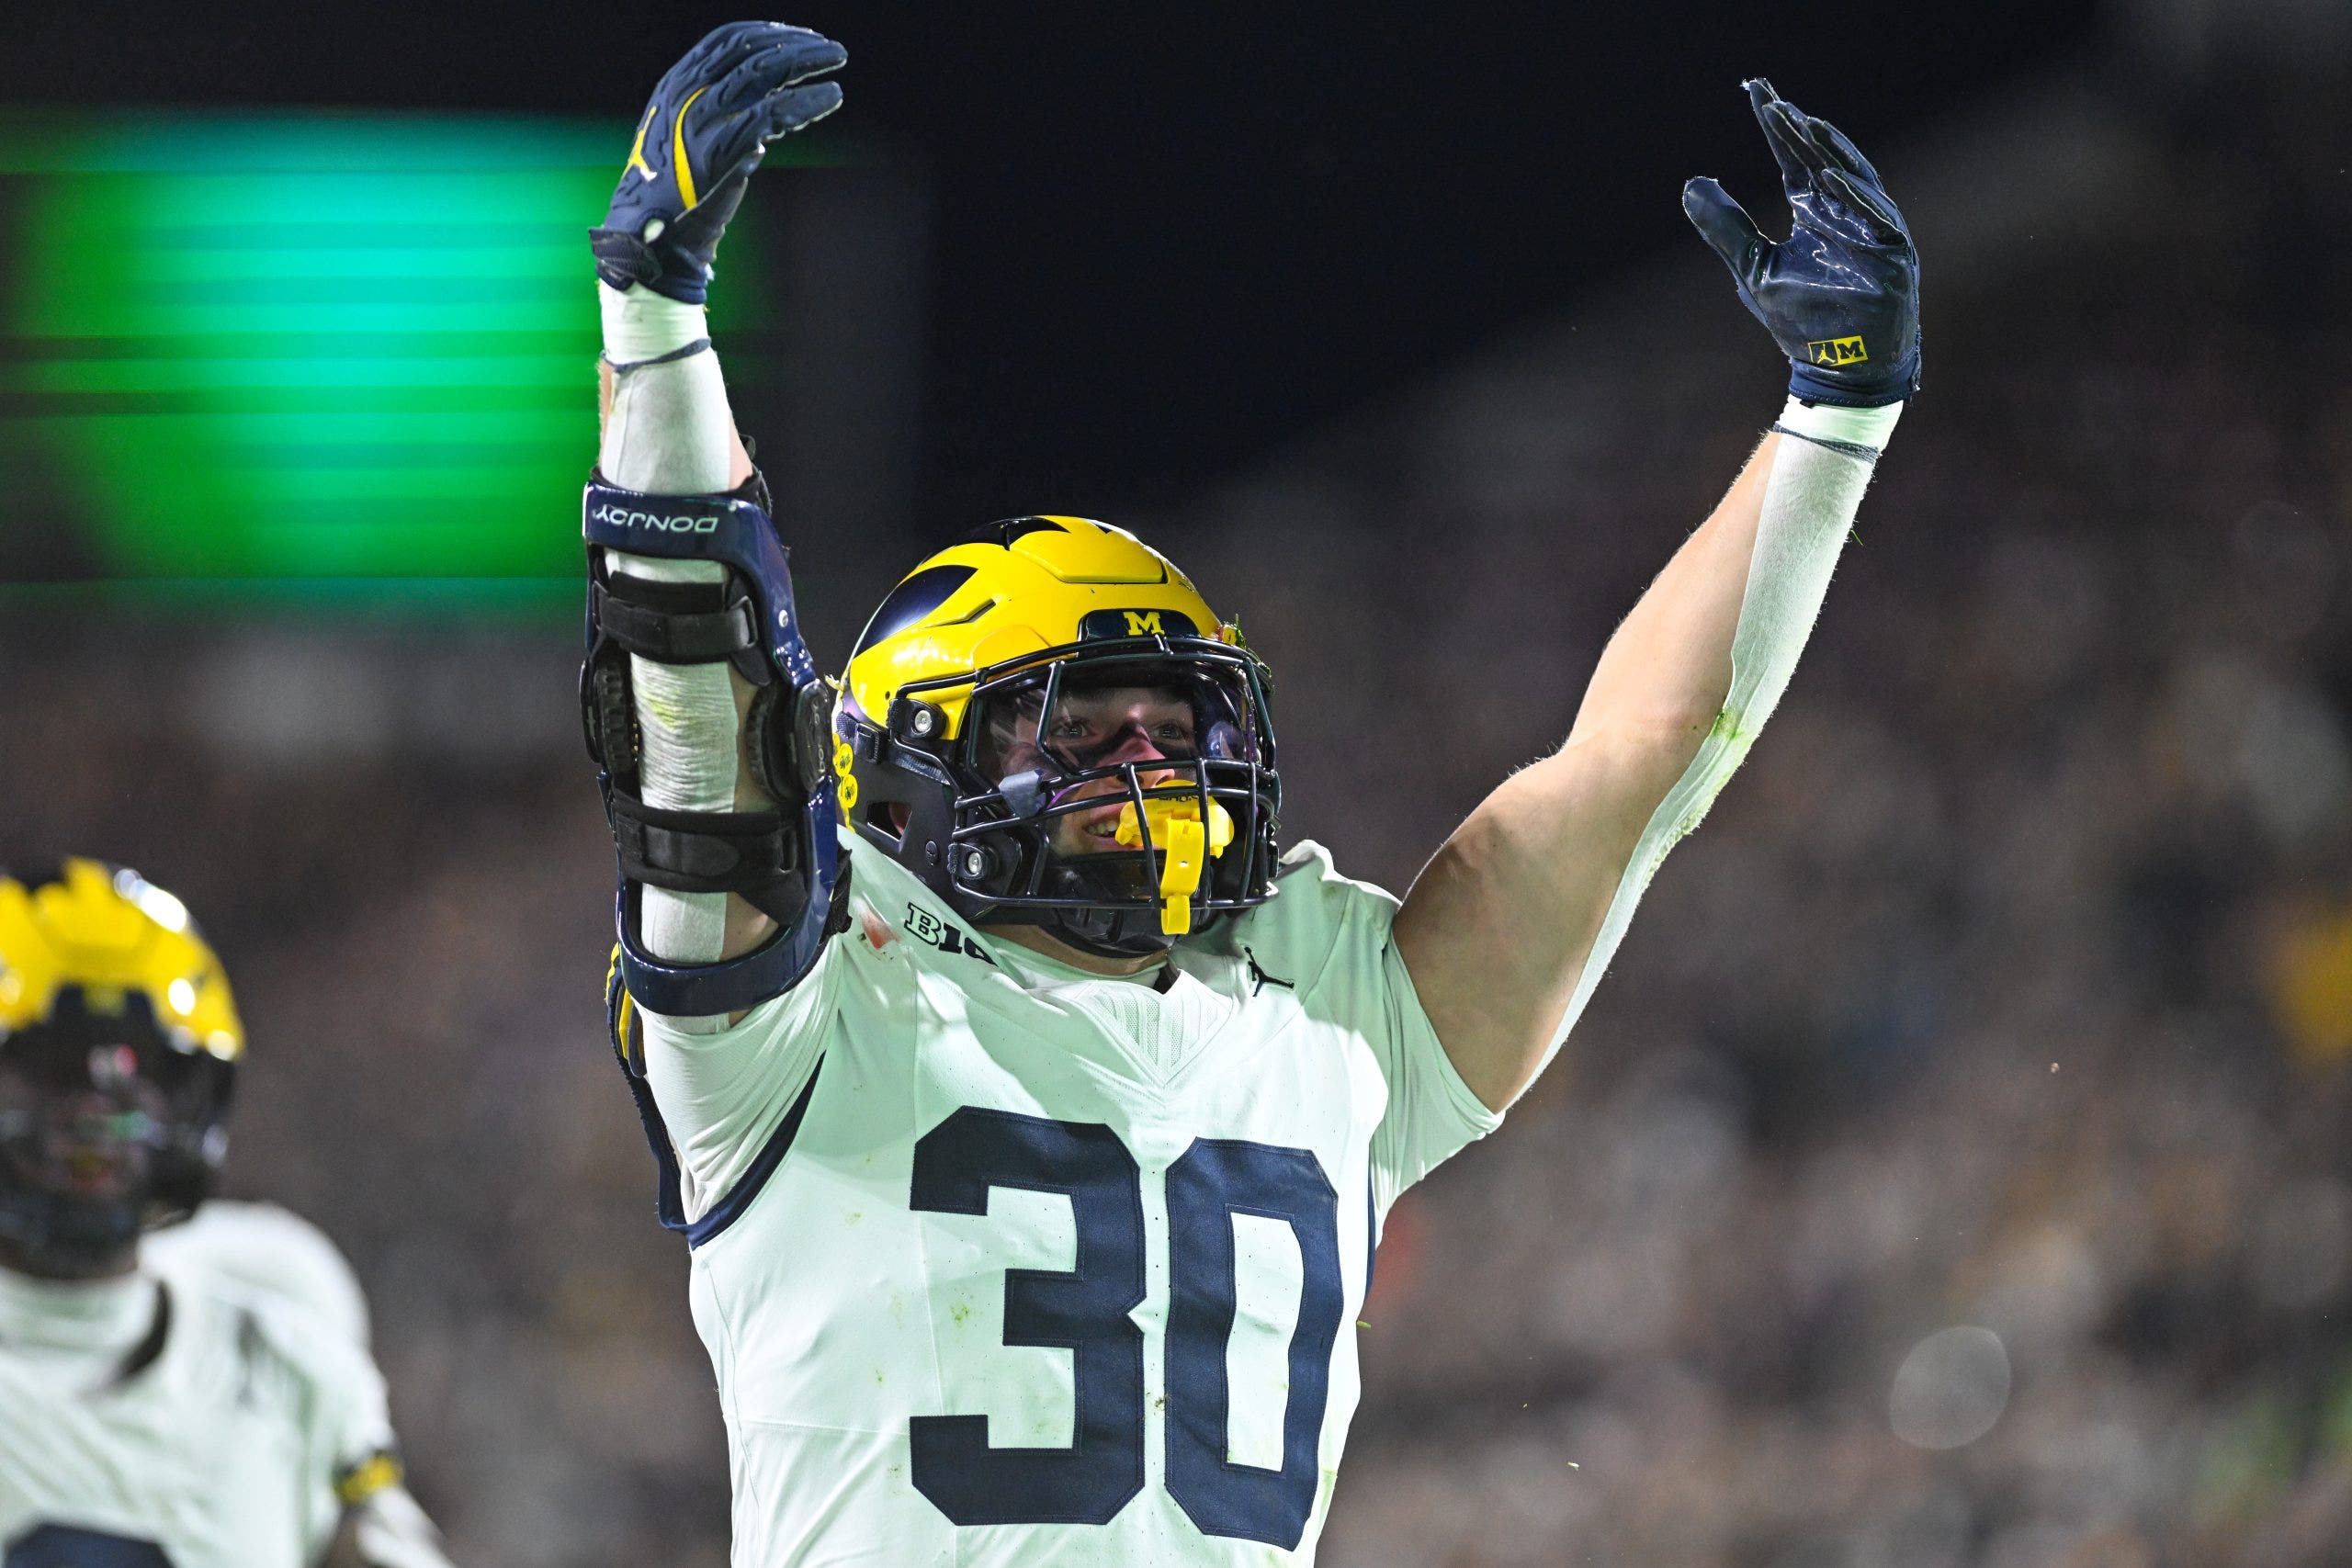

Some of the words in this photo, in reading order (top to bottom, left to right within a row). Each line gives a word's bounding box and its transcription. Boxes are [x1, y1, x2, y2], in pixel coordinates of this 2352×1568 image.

[1838, 341, 1863, 359] M
[595, 504, 718, 533] DONJOY
[1123, 612, 1165, 636] M
[910, 1105, 1343, 1552] 30
